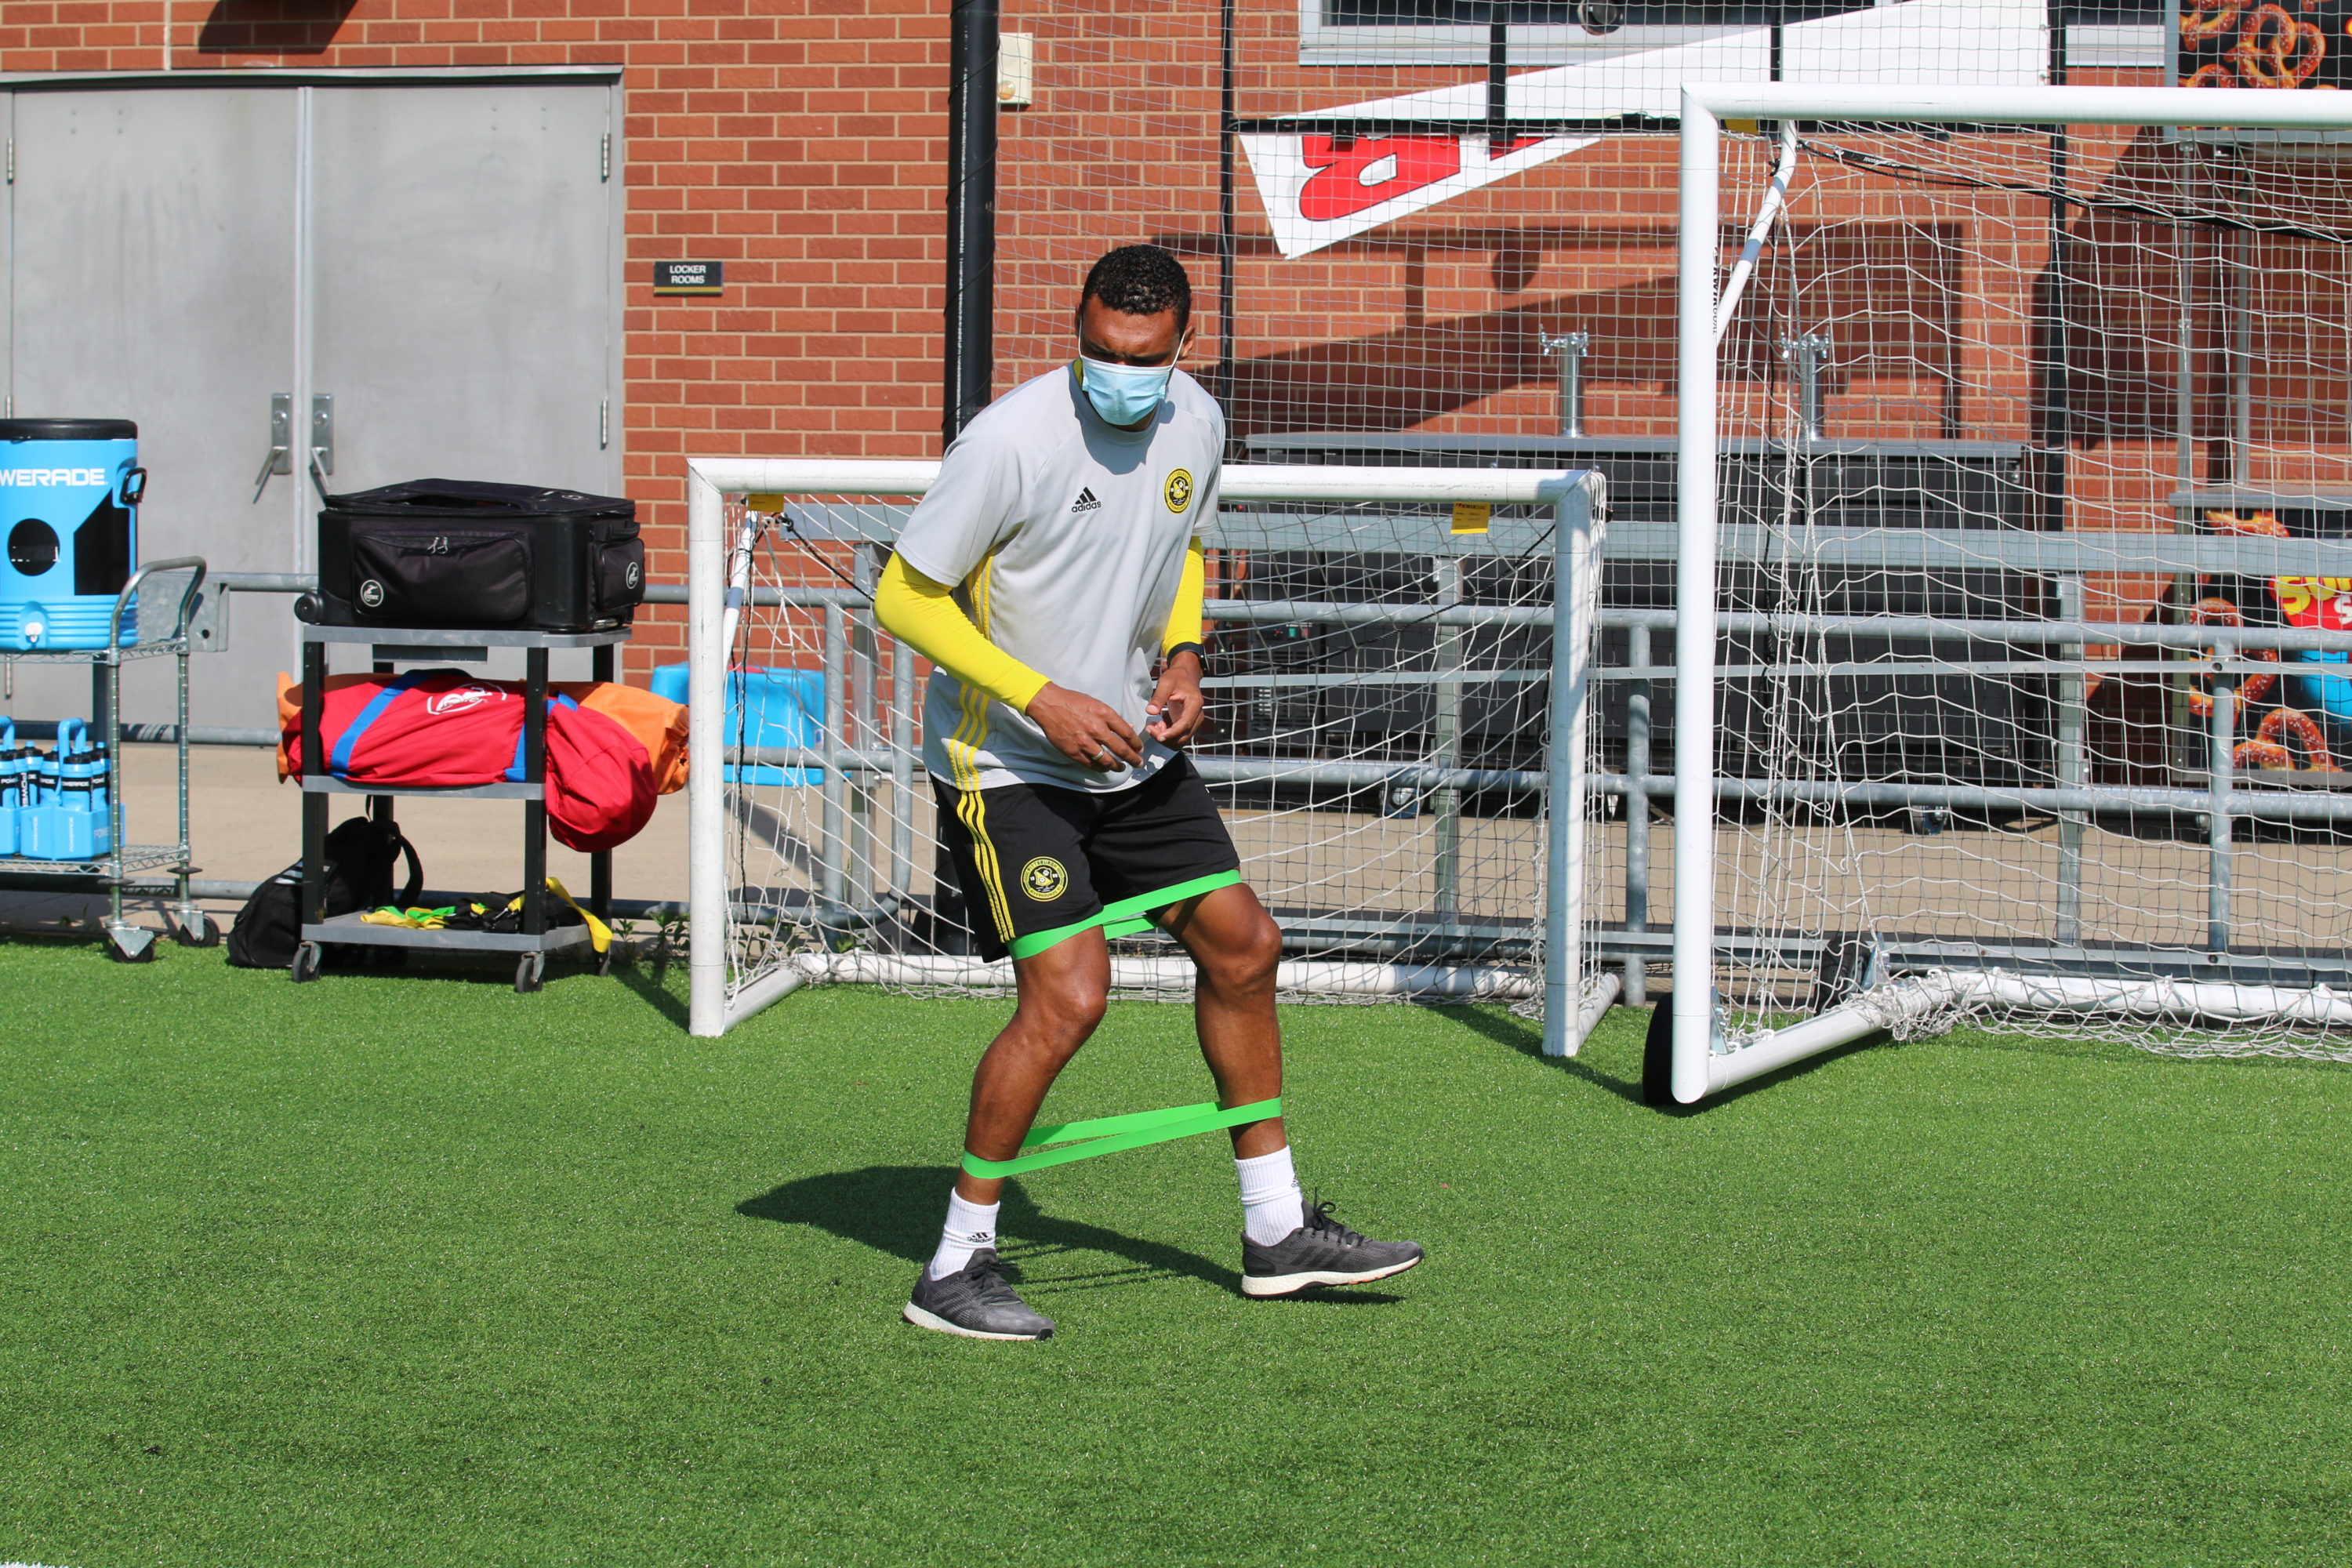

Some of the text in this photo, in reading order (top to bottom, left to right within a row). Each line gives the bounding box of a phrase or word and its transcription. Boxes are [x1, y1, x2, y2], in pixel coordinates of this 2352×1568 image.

[670, 265, 706, 274] LOCKER
[671, 275, 705, 284] ROOMS
[1071, 500, 1102, 513] adidas
